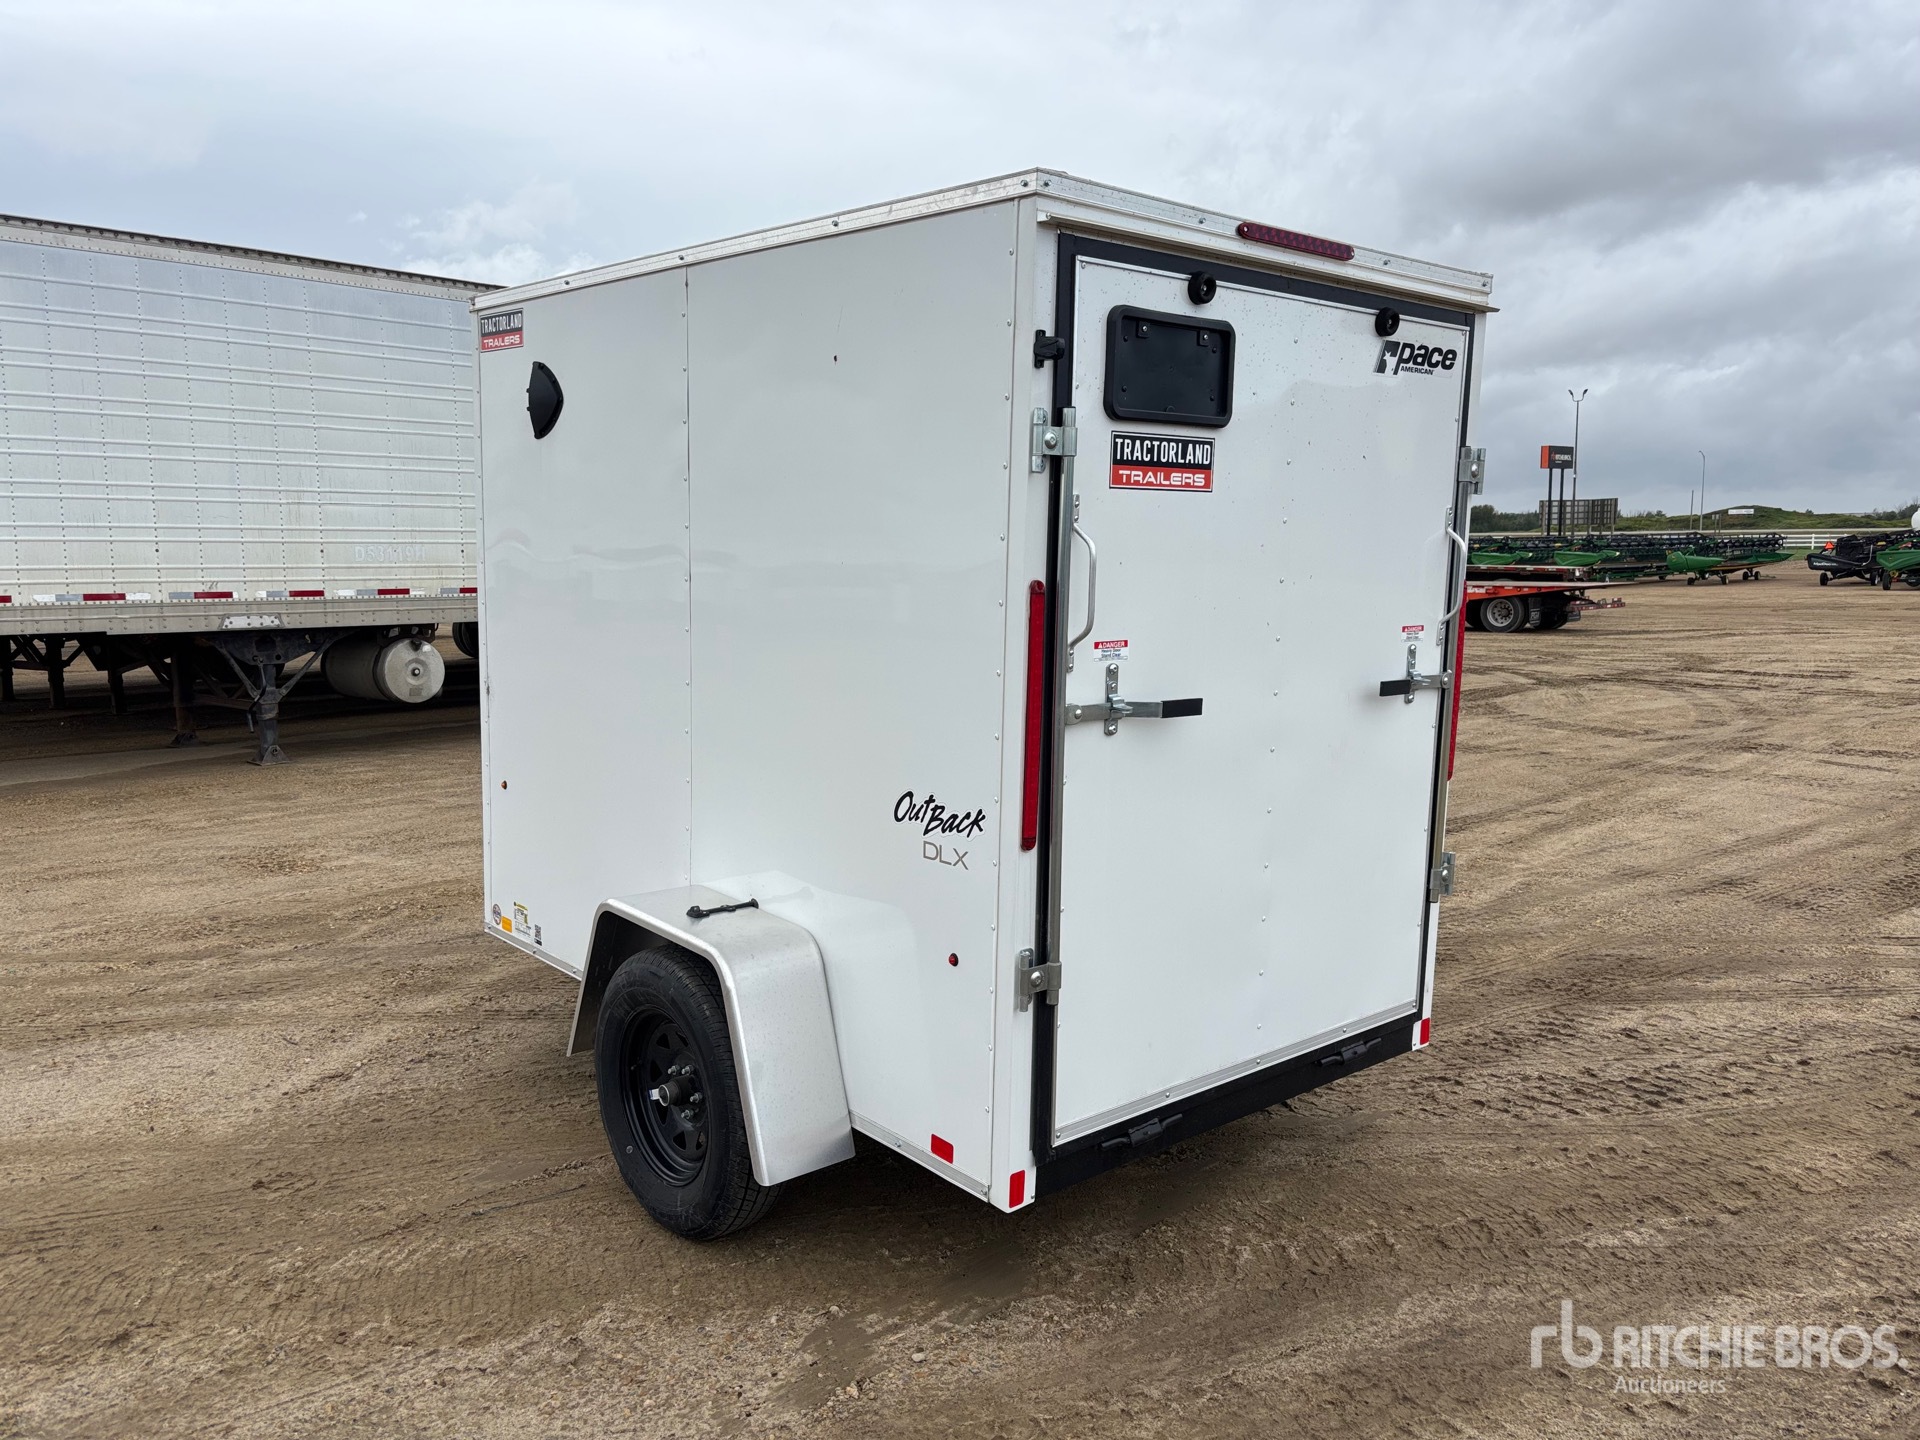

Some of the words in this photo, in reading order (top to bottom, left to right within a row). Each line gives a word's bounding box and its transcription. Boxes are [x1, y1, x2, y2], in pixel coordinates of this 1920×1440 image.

[481, 313, 522, 334] TRACTORLAND
[483, 334, 521, 348] TRAILERS
[1393, 342, 1457, 376] pace
[1400, 365, 1434, 376] AMERICAN
[1115, 438, 1211, 465] TRACTORLAND
[1119, 469, 1205, 487] TRAILERS
[1102, 641, 1125, 649] DANGER
[923, 840, 969, 871] DLX
